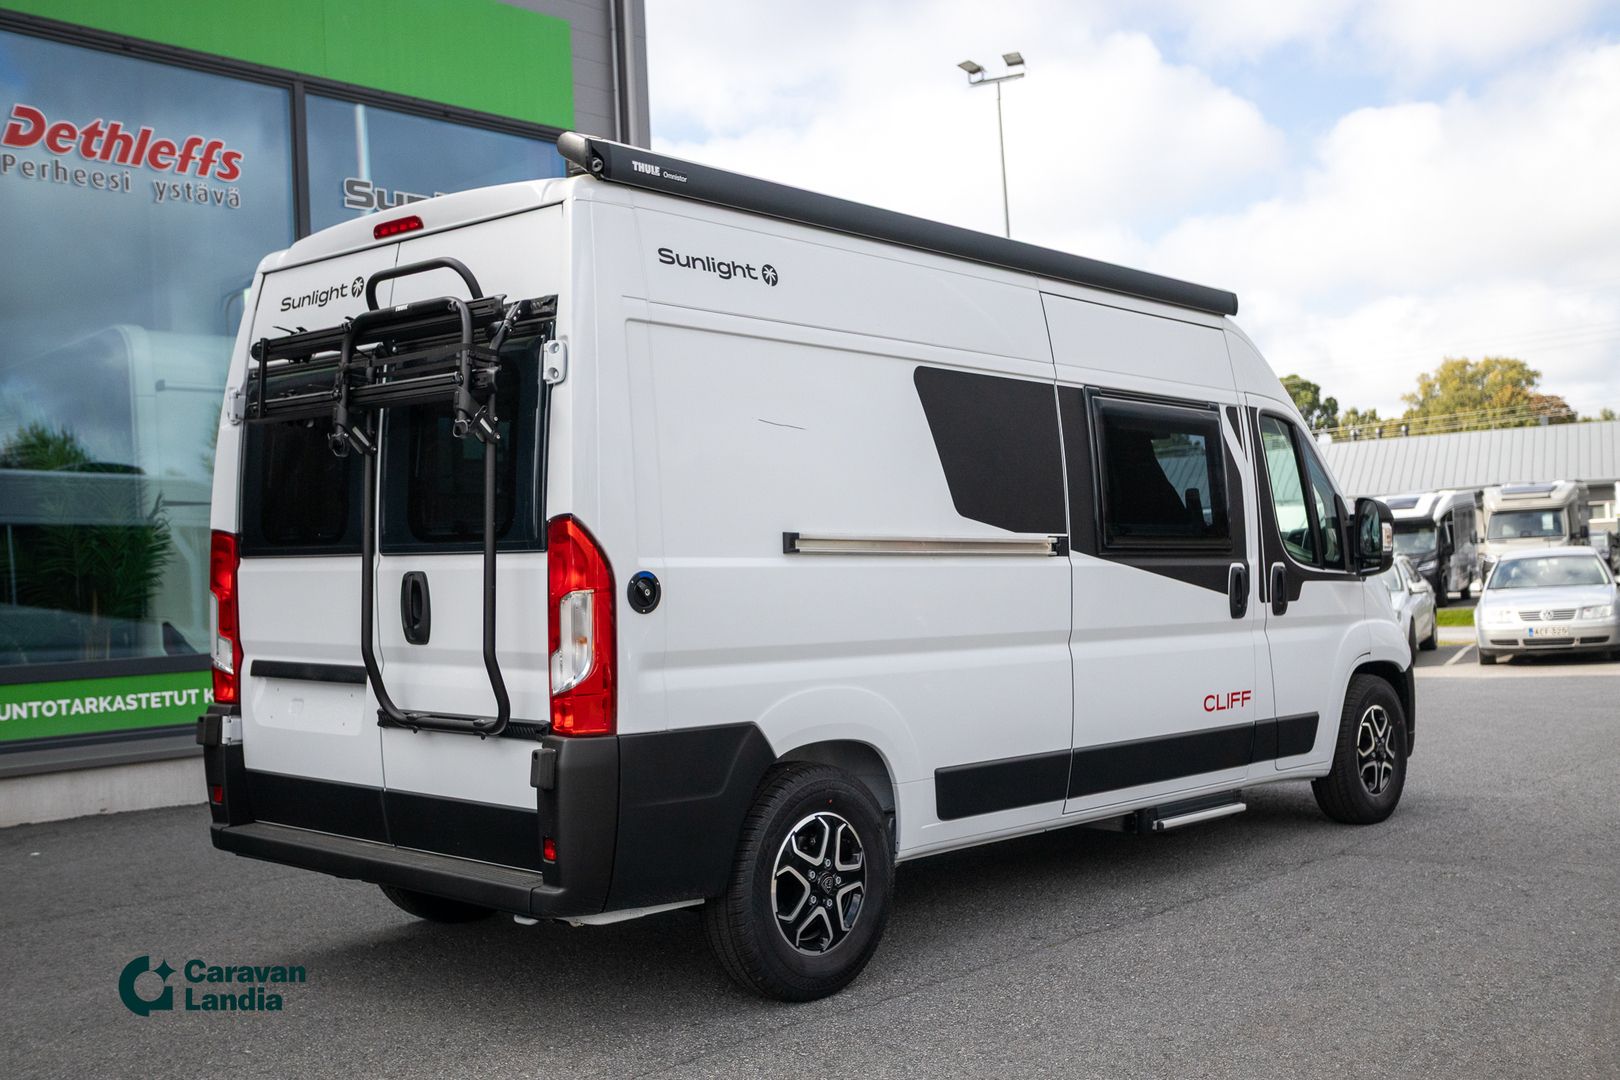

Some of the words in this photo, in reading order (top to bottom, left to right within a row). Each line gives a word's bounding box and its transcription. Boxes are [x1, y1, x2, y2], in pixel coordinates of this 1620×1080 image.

[2, 104, 243, 181] Dethleffs
[1, 154, 130, 191] Perheesi
[154, 180, 240, 208] ystävä
[632, 160, 661, 177] THULE
[658, 248, 759, 280] Sunlight
[280, 283, 348, 312] Sunlight
[1203, 690, 1252, 712] CLIFF
